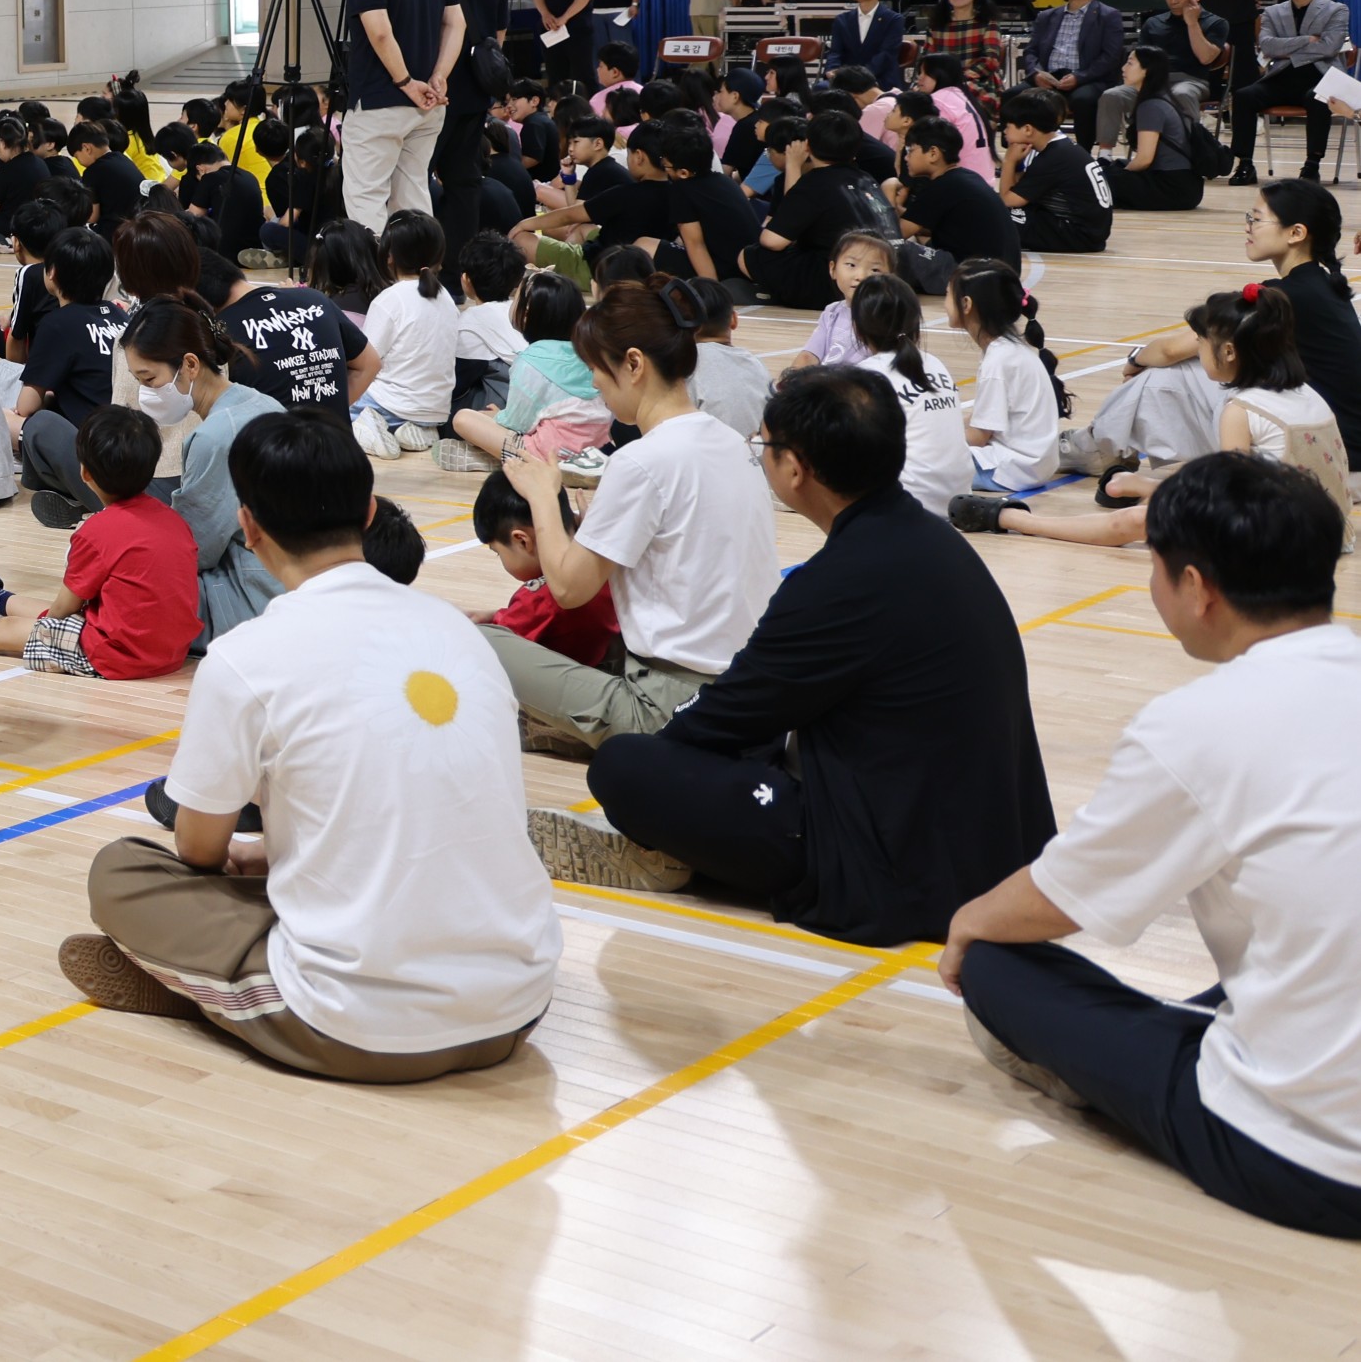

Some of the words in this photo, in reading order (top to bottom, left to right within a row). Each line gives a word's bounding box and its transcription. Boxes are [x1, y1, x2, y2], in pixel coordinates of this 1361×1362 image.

[672, 45, 701, 54] 교육감
[274, 354, 306, 371] YANKEE
[308, 347, 341, 363] STADIUM
[924, 396, 956, 412] ARMY
